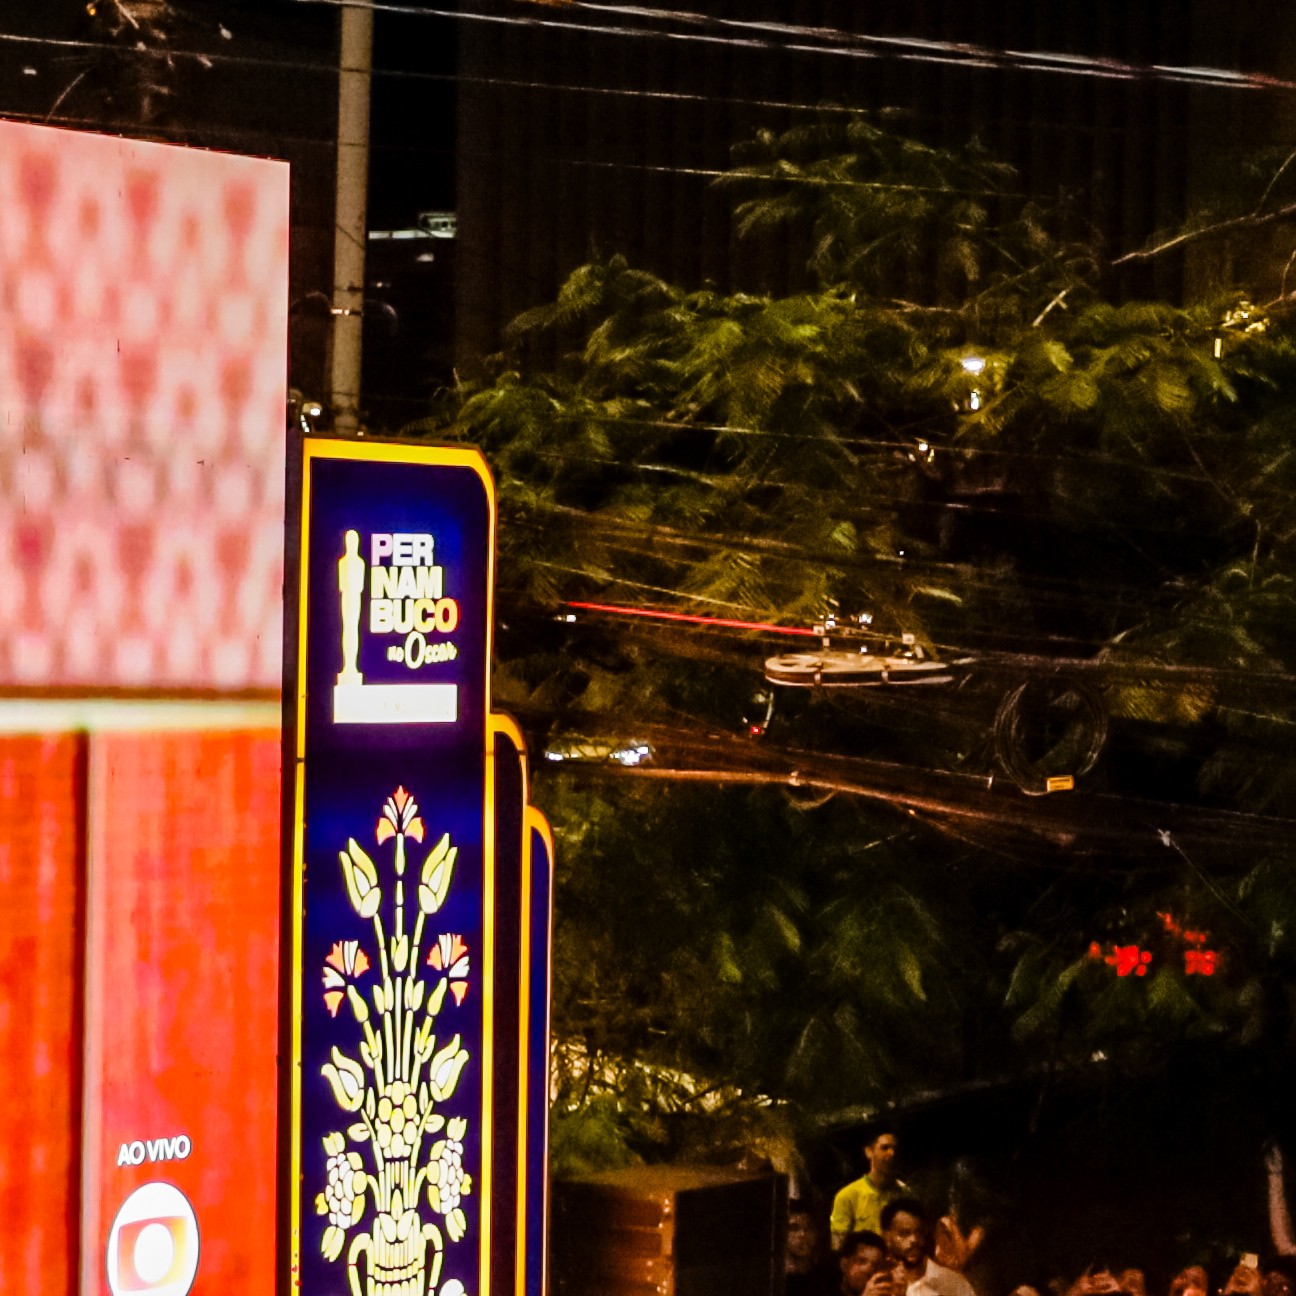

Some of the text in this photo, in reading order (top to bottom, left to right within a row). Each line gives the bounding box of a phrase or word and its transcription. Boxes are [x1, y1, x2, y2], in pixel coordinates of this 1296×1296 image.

[371, 533, 434, 566] PER
[371, 566, 443, 599] NAM
[370, 598, 460, 633] BUCO
[117, 1134, 192, 1166] AO VIVO
